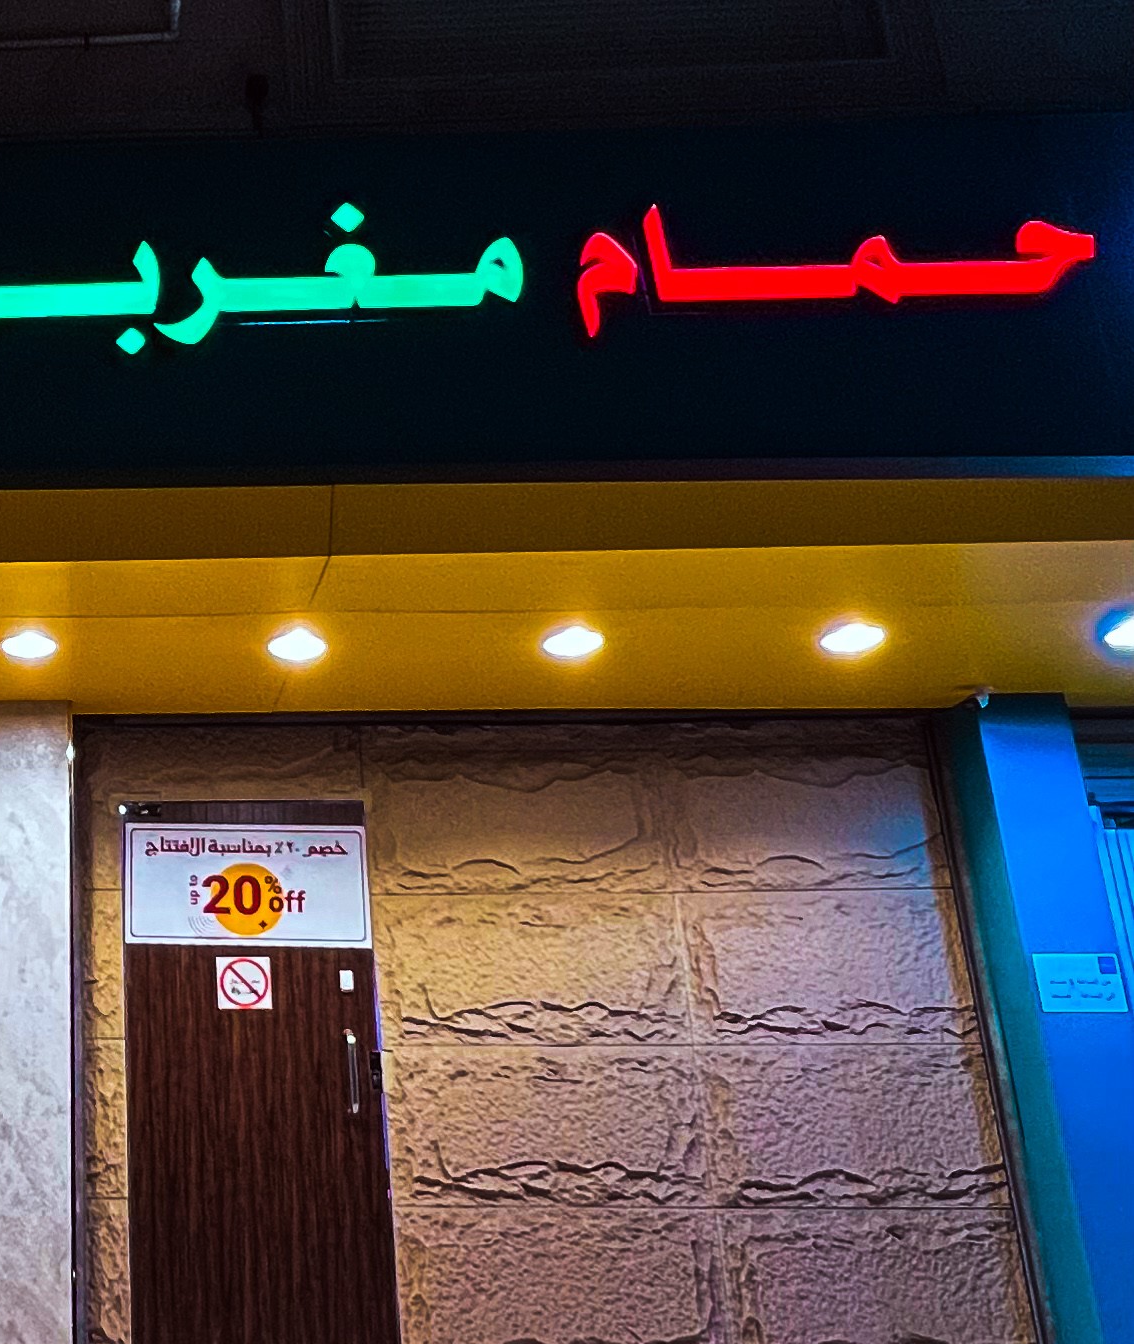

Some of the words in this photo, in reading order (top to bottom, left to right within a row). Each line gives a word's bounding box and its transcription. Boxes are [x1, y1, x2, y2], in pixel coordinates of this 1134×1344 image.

[576, 204, 1096, 339] حمام
[207, 837, 272, 858] بمناسبة
[302, 839, 349, 858] خصم
[188, 874, 198, 887] to
[190, 889, 201, 906] up
[268, 890, 307, 913] off
